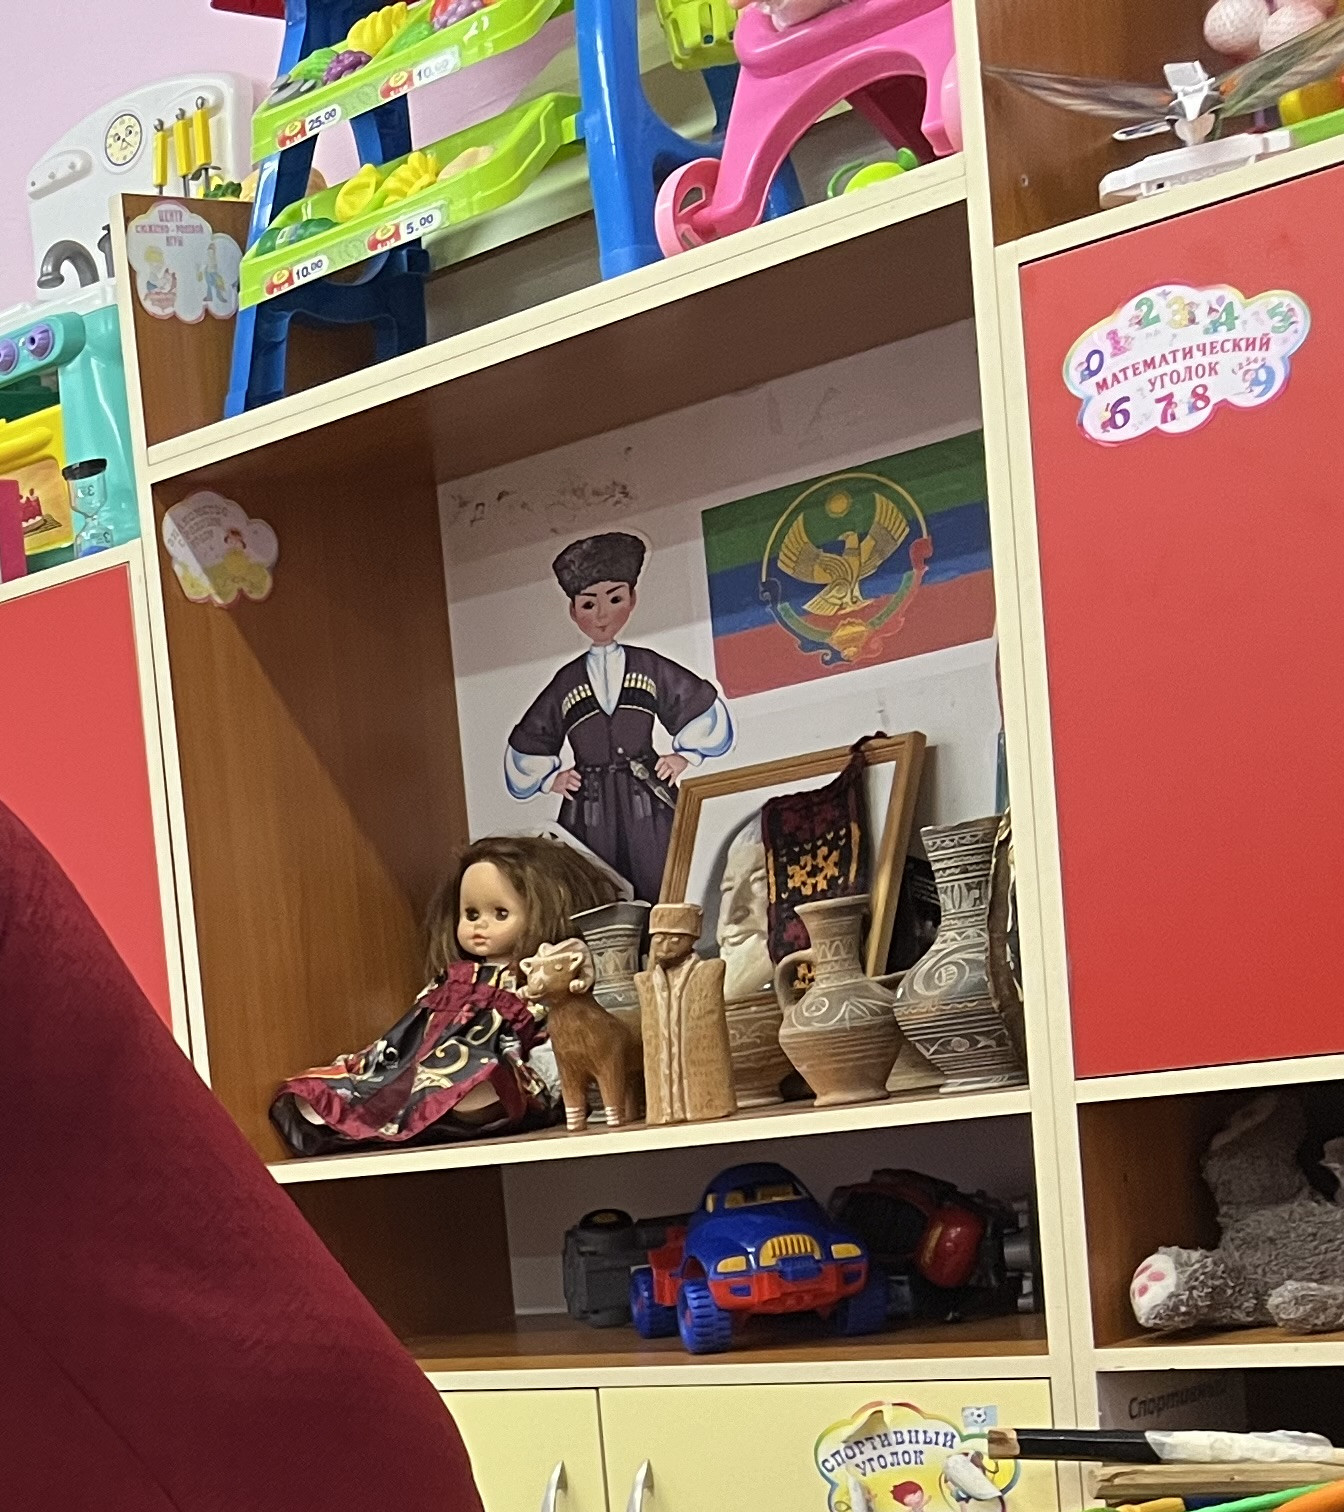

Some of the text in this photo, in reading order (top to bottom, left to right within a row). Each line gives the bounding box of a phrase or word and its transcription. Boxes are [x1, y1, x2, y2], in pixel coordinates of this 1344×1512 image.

[308, 108, 337, 132] 25.00
[406, 214, 434, 235] 5.00
[296, 259, 323, 280] 10.00
[1095, 333, 1272, 396] МАТЕМАТИЧЕСКИЙ
[1147, 361, 1220, 394] УГОЛОК
[821, 1429, 957, 1474] СПОРТИВНЫЙ
[855, 1449, 924, 1477] УГОЛОК
